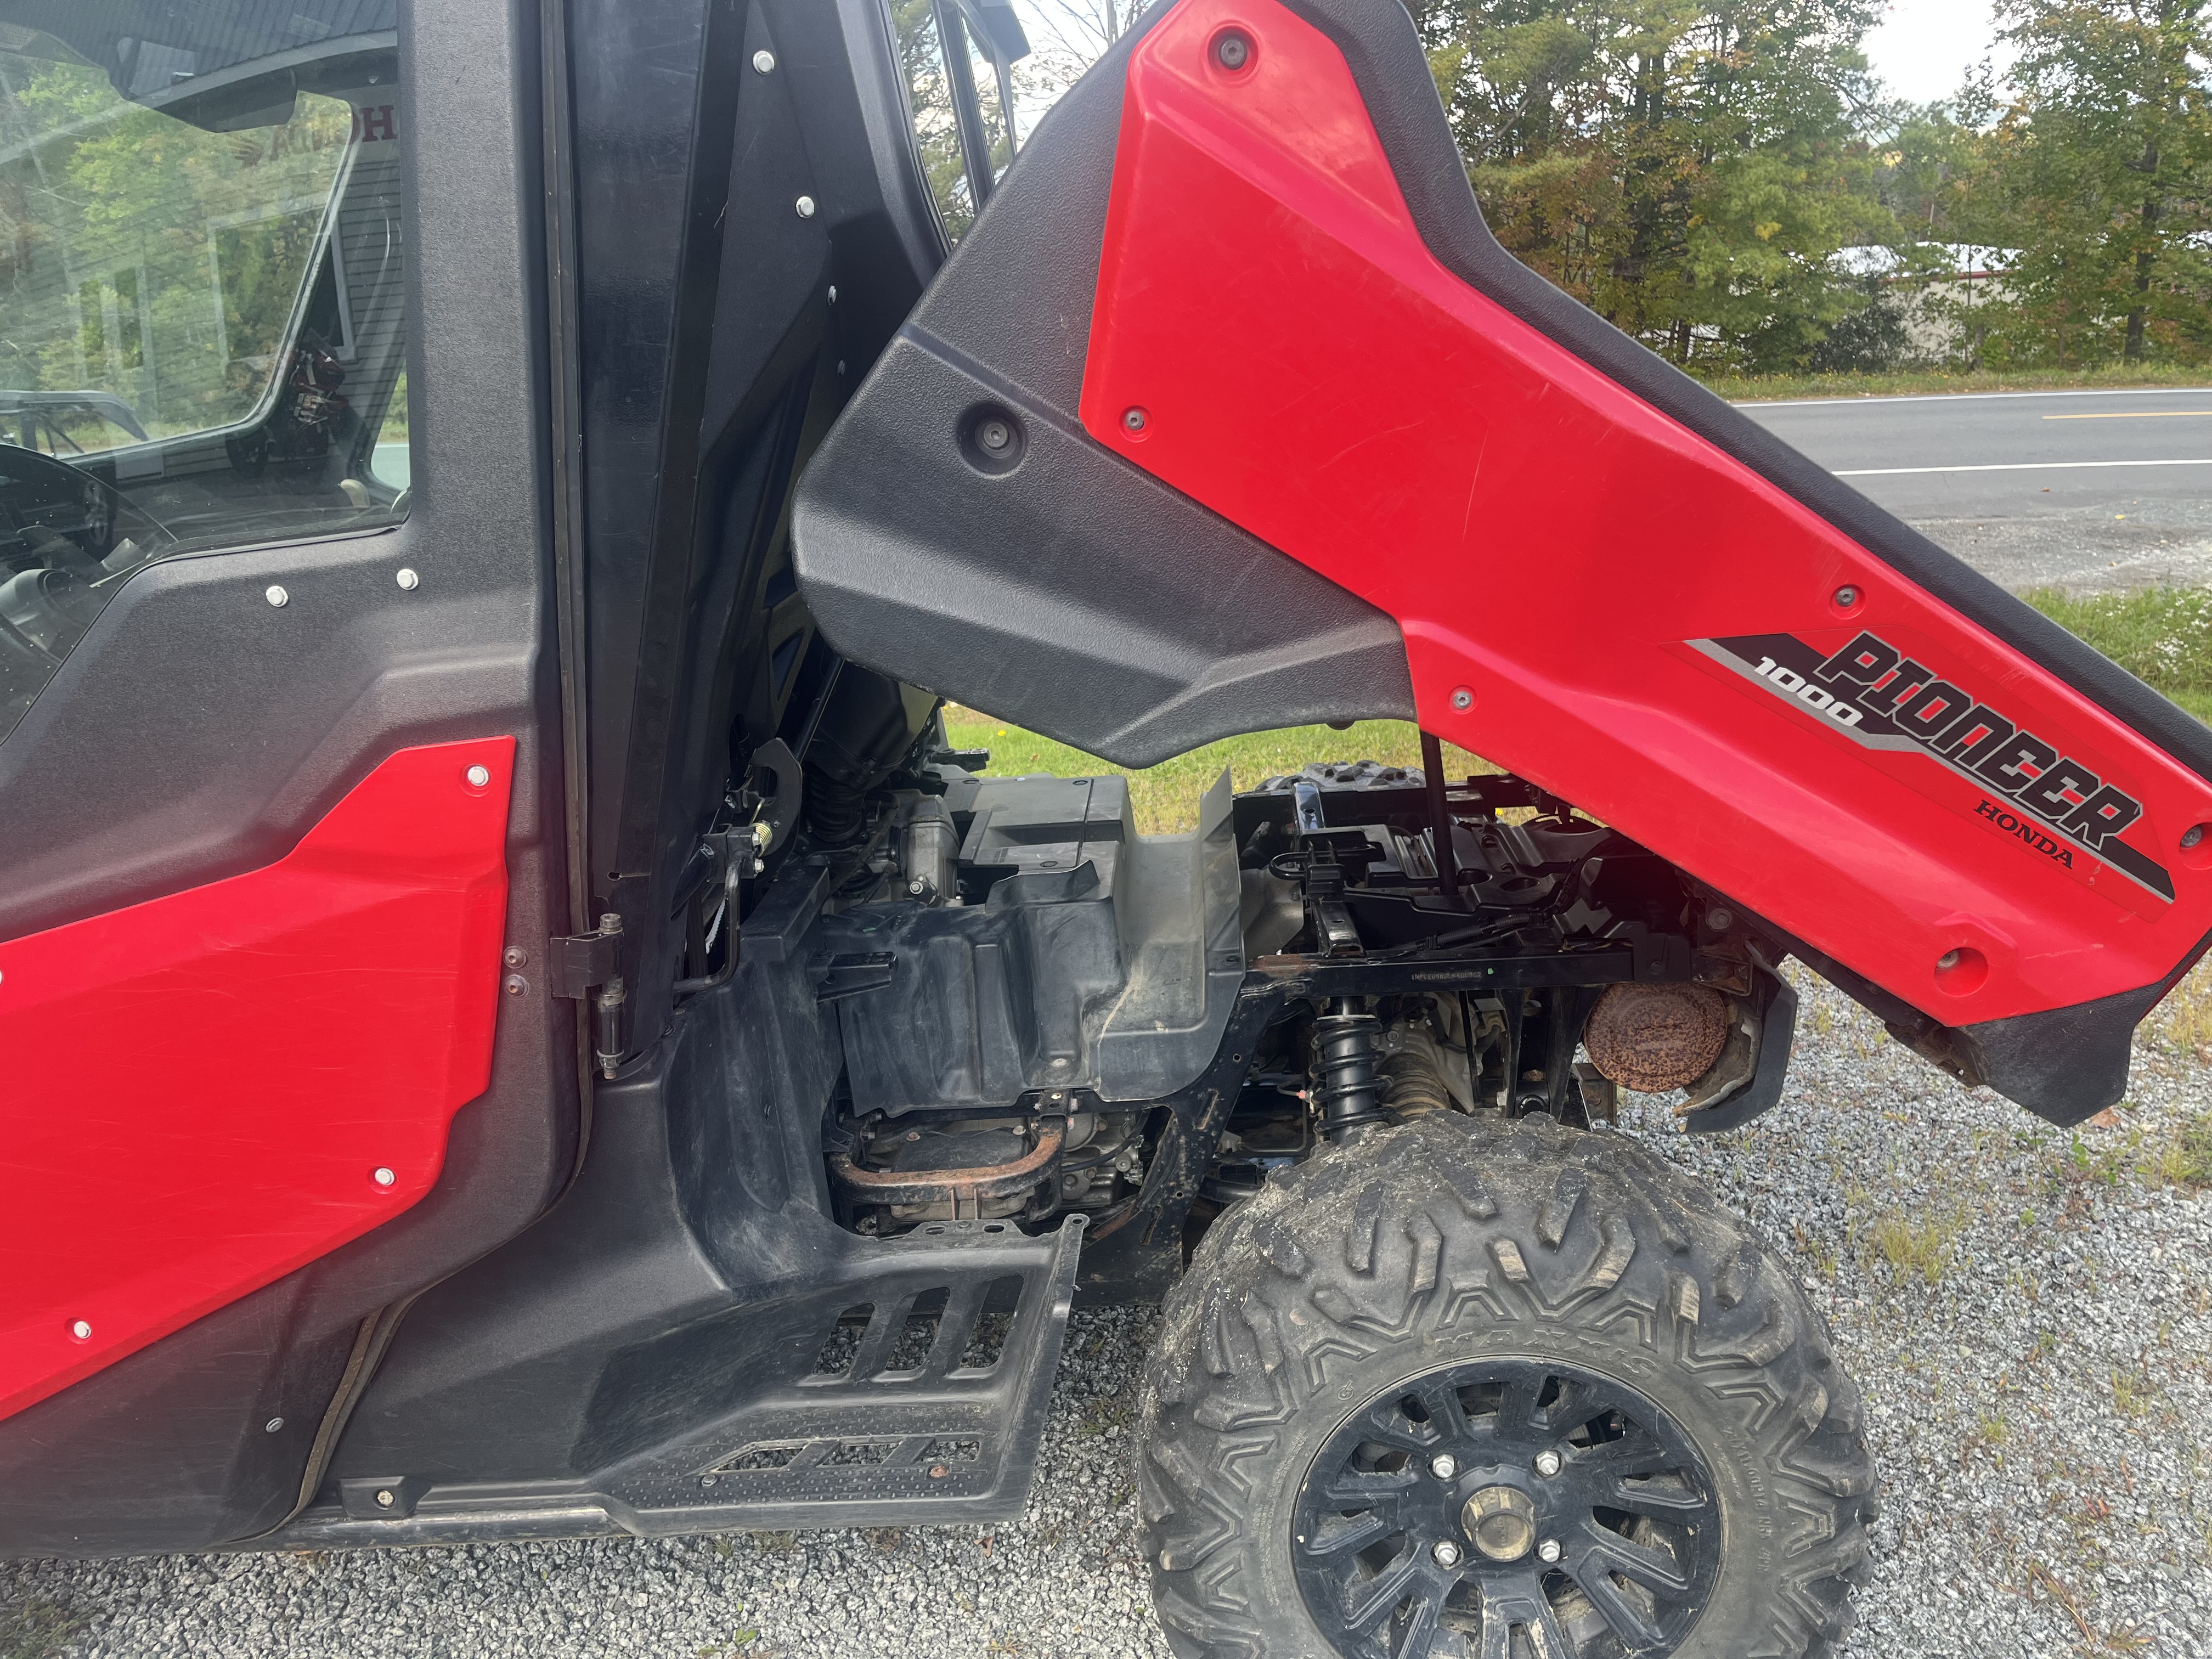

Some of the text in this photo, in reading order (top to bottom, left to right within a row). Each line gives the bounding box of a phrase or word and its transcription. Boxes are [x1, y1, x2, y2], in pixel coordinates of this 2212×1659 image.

[1753, 656, 1864, 727] 1000
[1812, 629, 2143, 851] PIONEER
[1973, 799, 2073, 865] HONDA
[1434, 1329, 1660, 1379] MAXXIS
